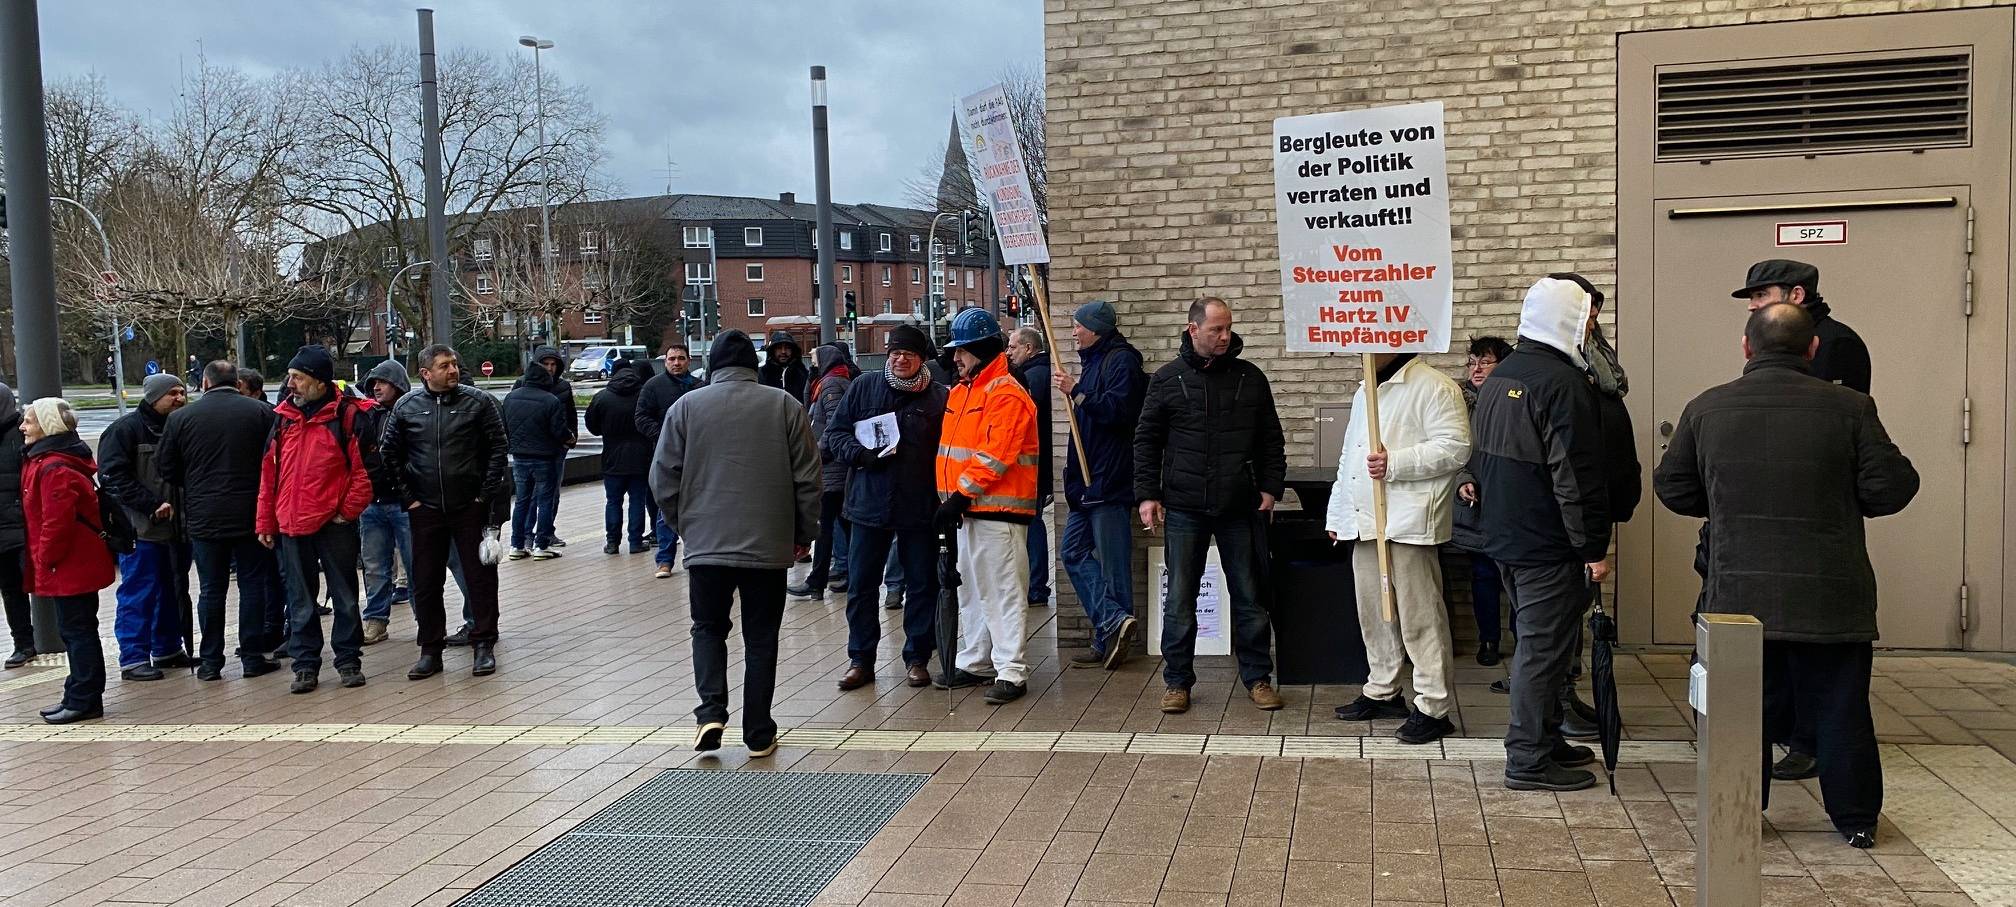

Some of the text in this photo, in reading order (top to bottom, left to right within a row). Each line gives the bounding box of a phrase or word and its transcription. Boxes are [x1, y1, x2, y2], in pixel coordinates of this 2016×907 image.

[1279, 125, 1435, 154] Bergleute von
[1298, 152, 1413, 178] der Politik
[1287, 177, 1431, 205] verraten und
[1305, 206, 1412, 230] verkauft!!
[1800, 228, 1824, 239] SPZ
[1333, 244, 1383, 262] Vom
[1293, 263, 1436, 283] Steuerzahler
[1339, 289, 1383, 303] zum
[1320, 305, 1411, 324] Hartz IV
[1308, 326, 1428, 347] Empfänger
